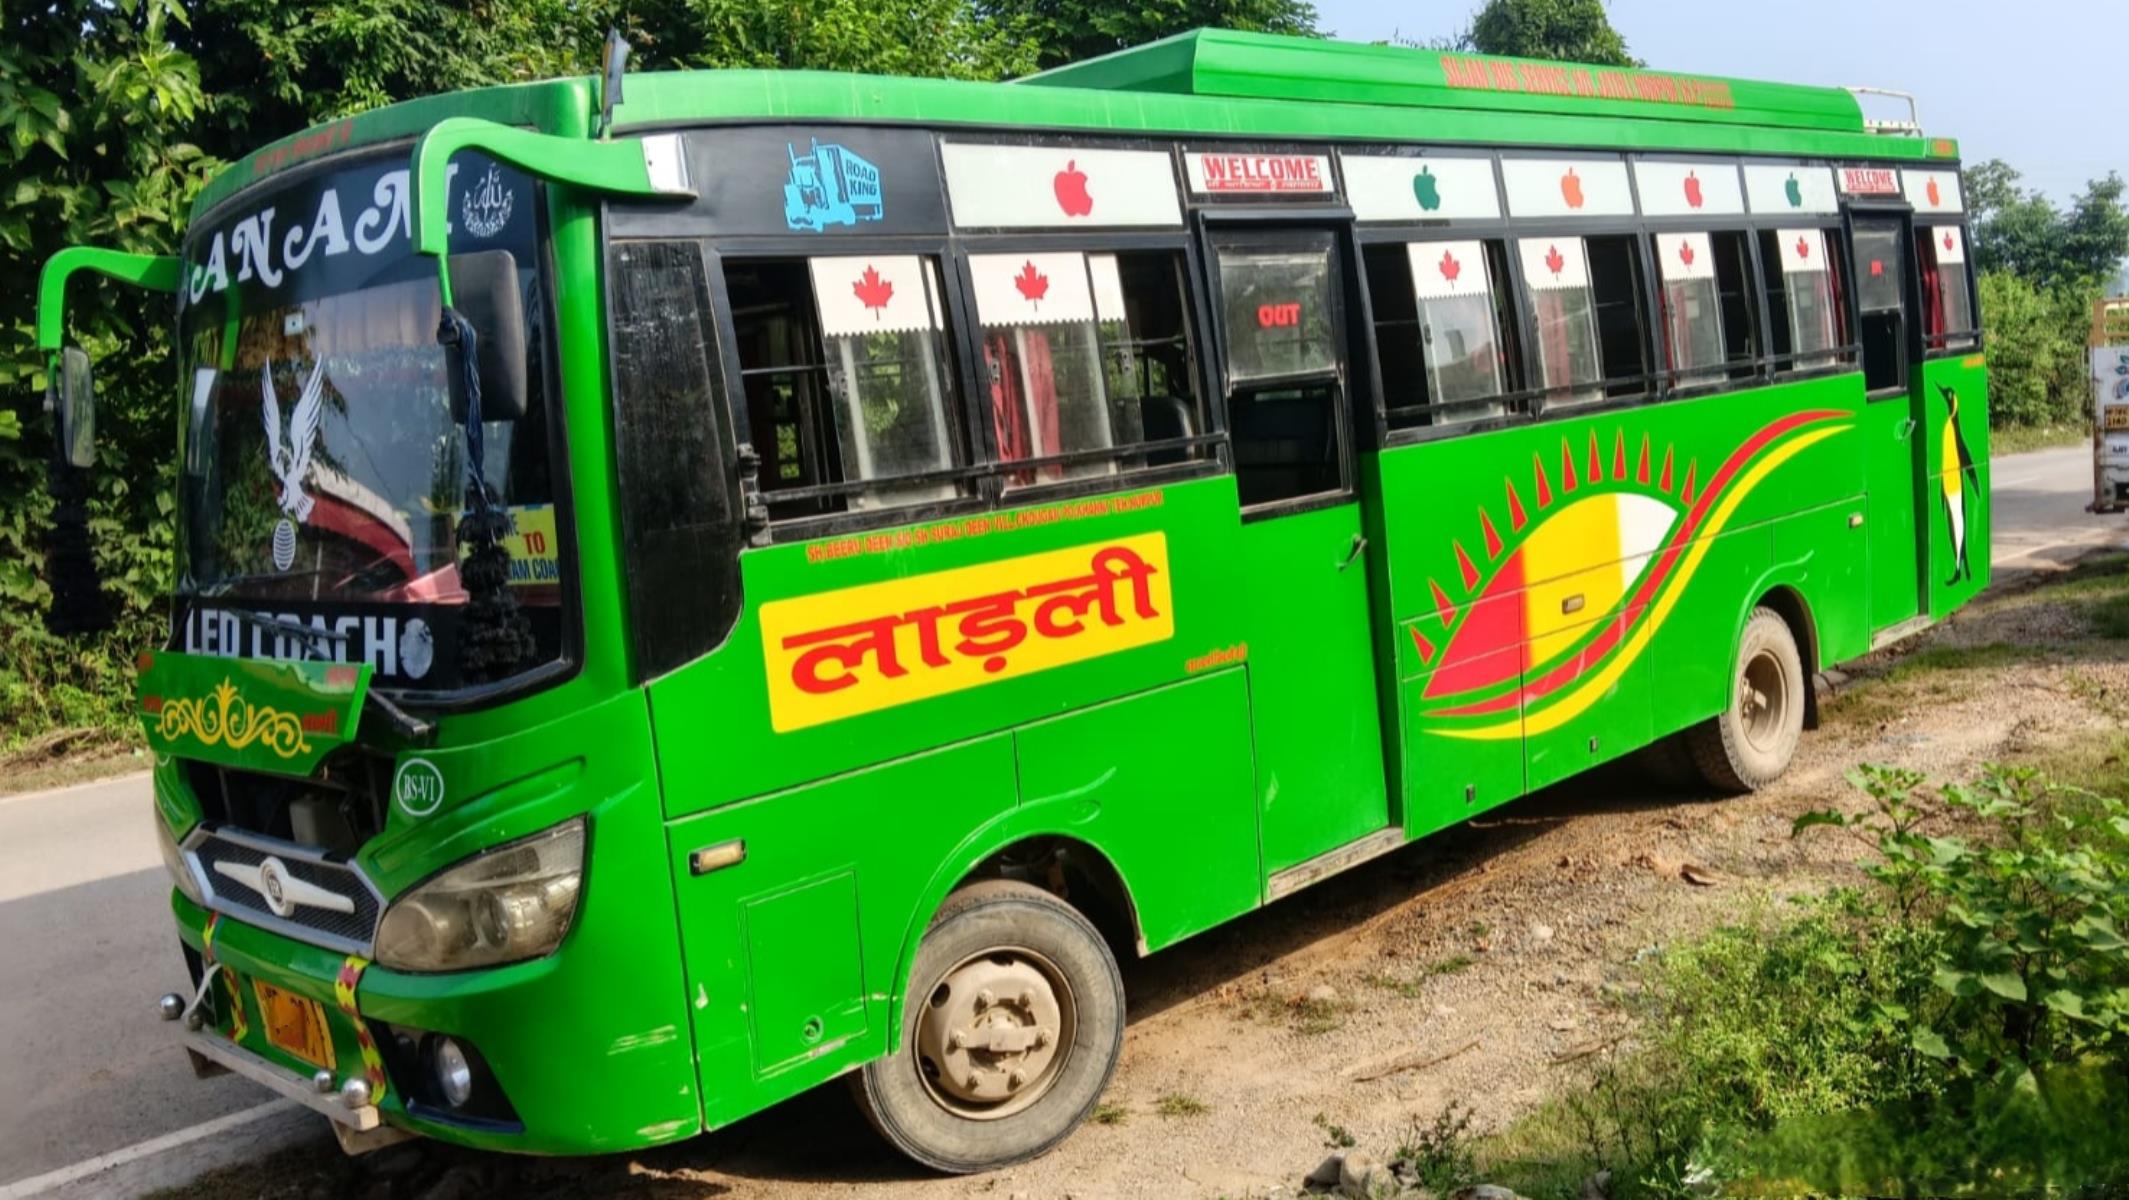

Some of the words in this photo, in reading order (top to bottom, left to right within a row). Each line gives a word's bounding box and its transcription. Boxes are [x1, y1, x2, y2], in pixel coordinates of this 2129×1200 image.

[846, 159, 876, 182] ROAD
[1204, 157, 1319, 180] WELCOME
[1846, 168, 1893, 186] WELCOME
[850, 179, 877, 196] KING
[1258, 303, 1302, 328] OUT
[523, 531, 546, 556] TO
[782, 546, 1160, 695] लाड़ली
[186, 608, 241, 658] LED
[252, 611, 397, 676] COACH
[404, 774, 435, 802] BS-VI
